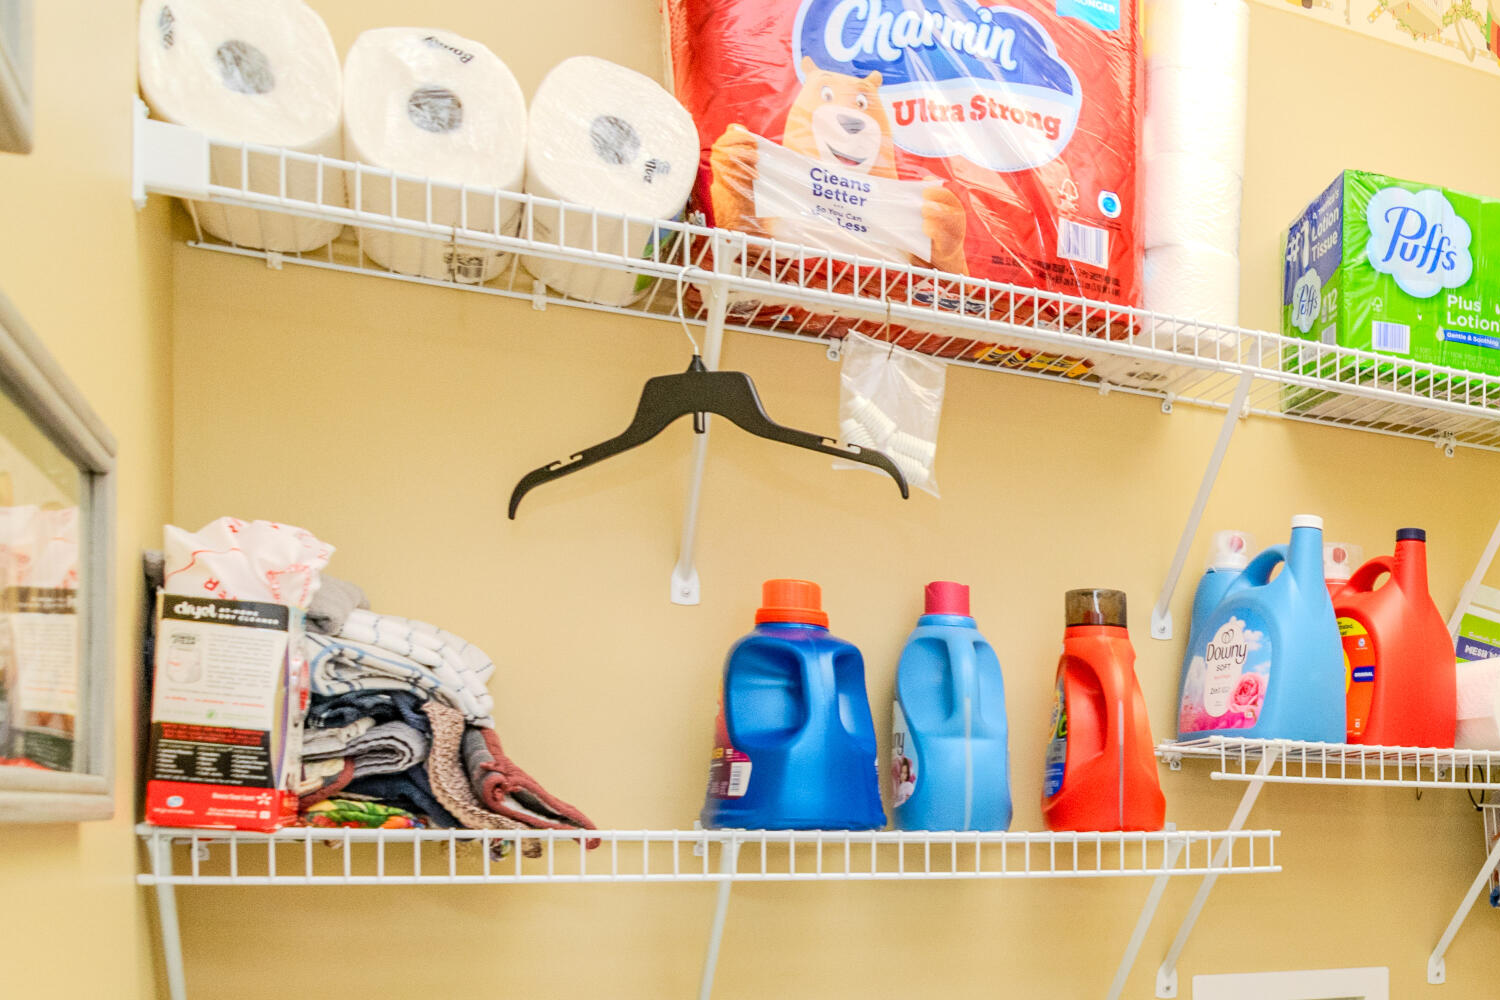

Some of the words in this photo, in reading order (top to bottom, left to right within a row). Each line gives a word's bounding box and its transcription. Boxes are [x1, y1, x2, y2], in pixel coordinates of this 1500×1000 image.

[824, 0, 1017, 71] Charmin
[892, 97, 966, 127] Ultra
[969, 94, 1061, 141] Strong
[810, 167, 871, 193] Cleans
[812, 183, 868, 207] Better
[1311, 207, 1340, 242] Lotion
[1286, 220, 1311, 268] #1
[1311, 230, 1339, 262] Tissue
[1382, 206, 1457, 274] Puffs
[1296, 284, 1319, 320] Puffs
[1447, 294, 1481, 312] Plus
[1447, 311, 1500, 333] Lotion
[1447, 332, 1467, 341] Gentle
[1206, 643, 1249, 665] Downy
[1464, 644, 1489, 659] MESH
